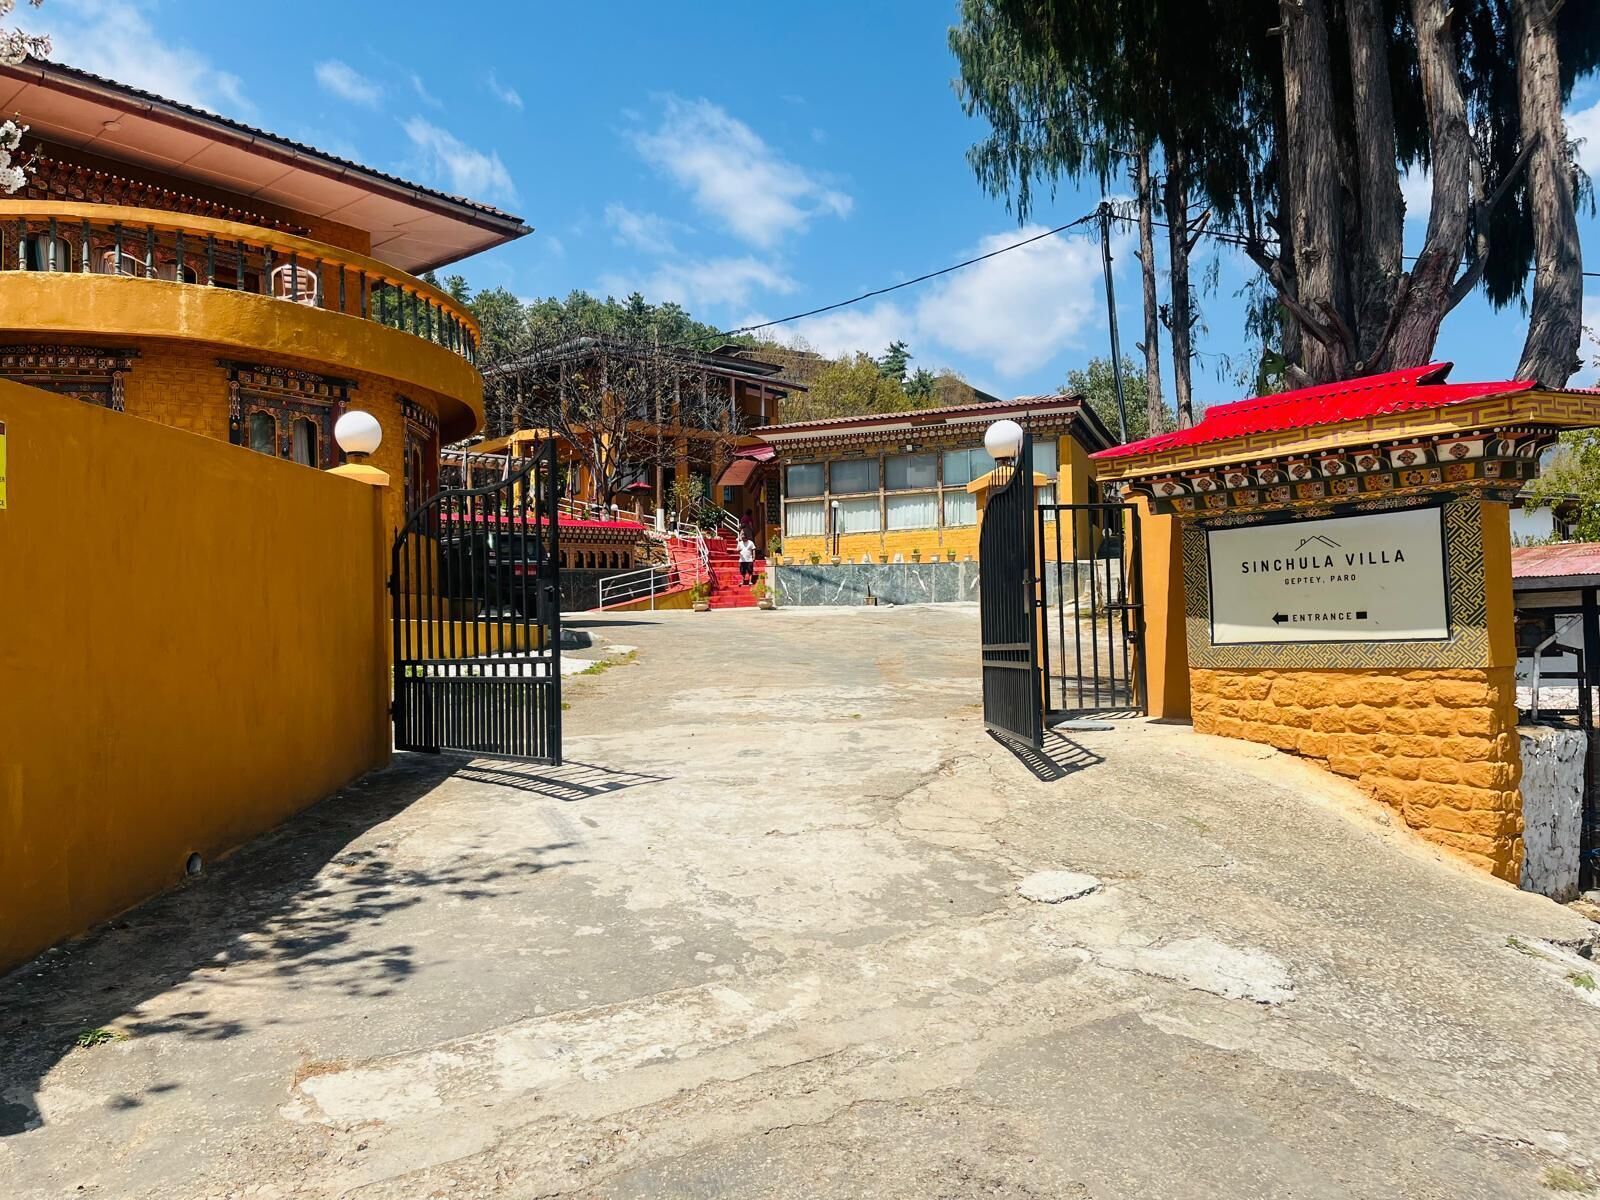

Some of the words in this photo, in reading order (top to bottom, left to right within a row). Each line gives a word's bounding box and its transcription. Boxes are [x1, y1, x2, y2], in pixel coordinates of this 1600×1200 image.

[1241, 555, 1334, 573] SINCHULA
[1345, 549, 1405, 566] VILLA
[1284, 576, 1325, 585] GEPTEY,
[1330, 574, 1357, 582] PARO
[1292, 611, 1353, 622] ENTRANCE
